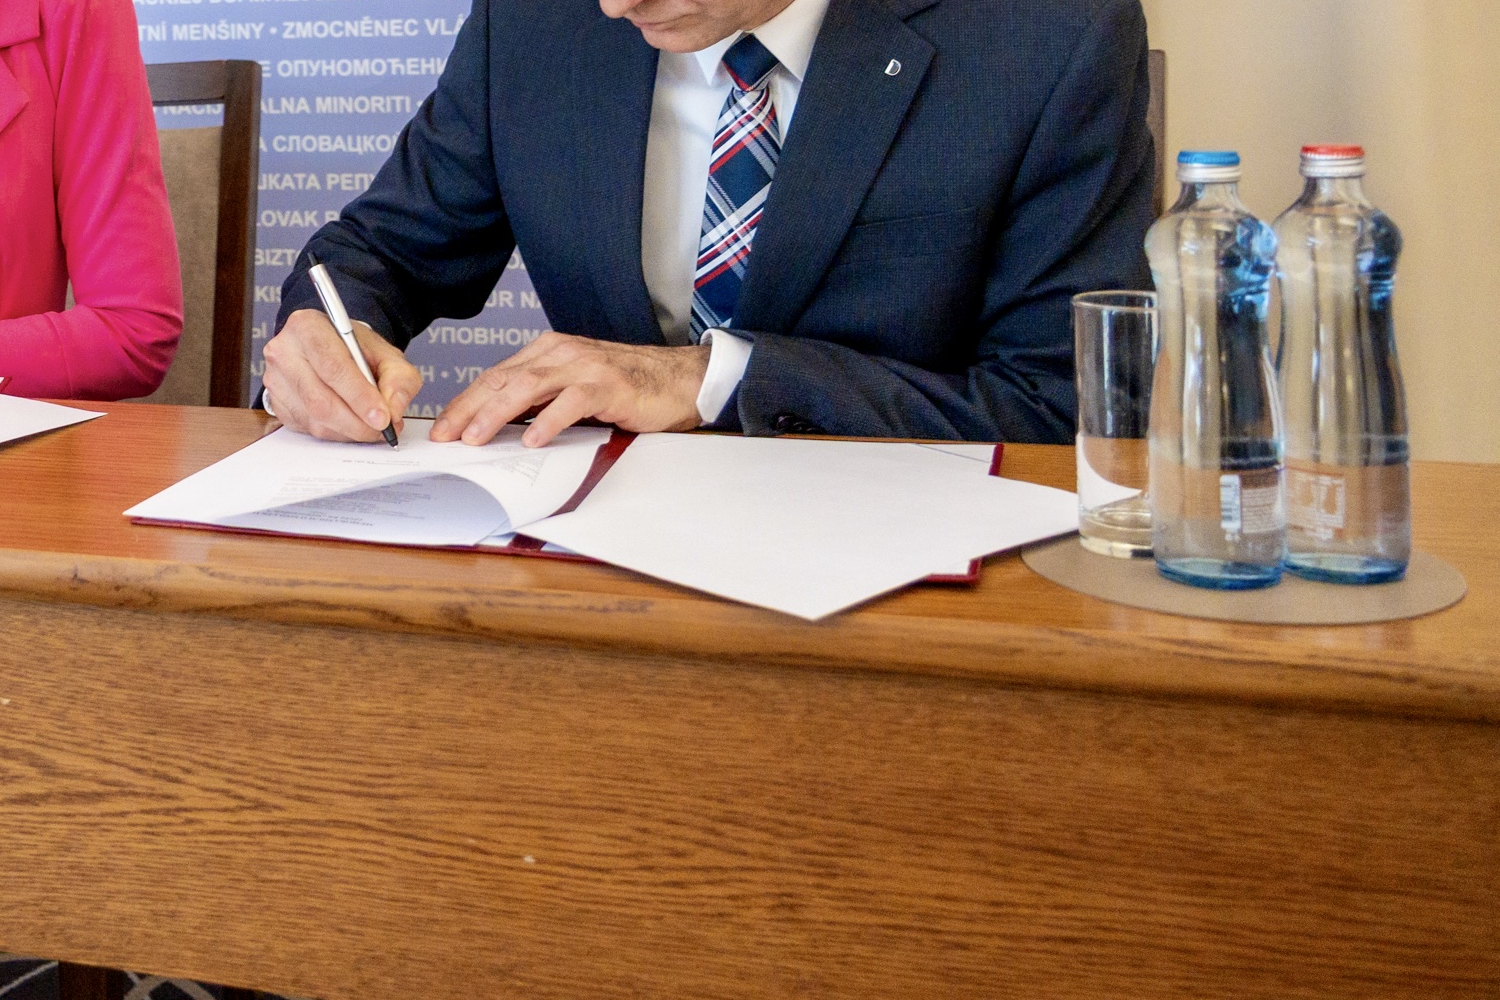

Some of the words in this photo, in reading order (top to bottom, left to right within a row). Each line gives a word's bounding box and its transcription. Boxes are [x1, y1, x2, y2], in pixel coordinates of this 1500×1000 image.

[172, 20, 264, 40] MENŠINY
[282, 16, 418, 39] ZMOCNĚNEC
[315, 95, 411, 113] MINORITI
